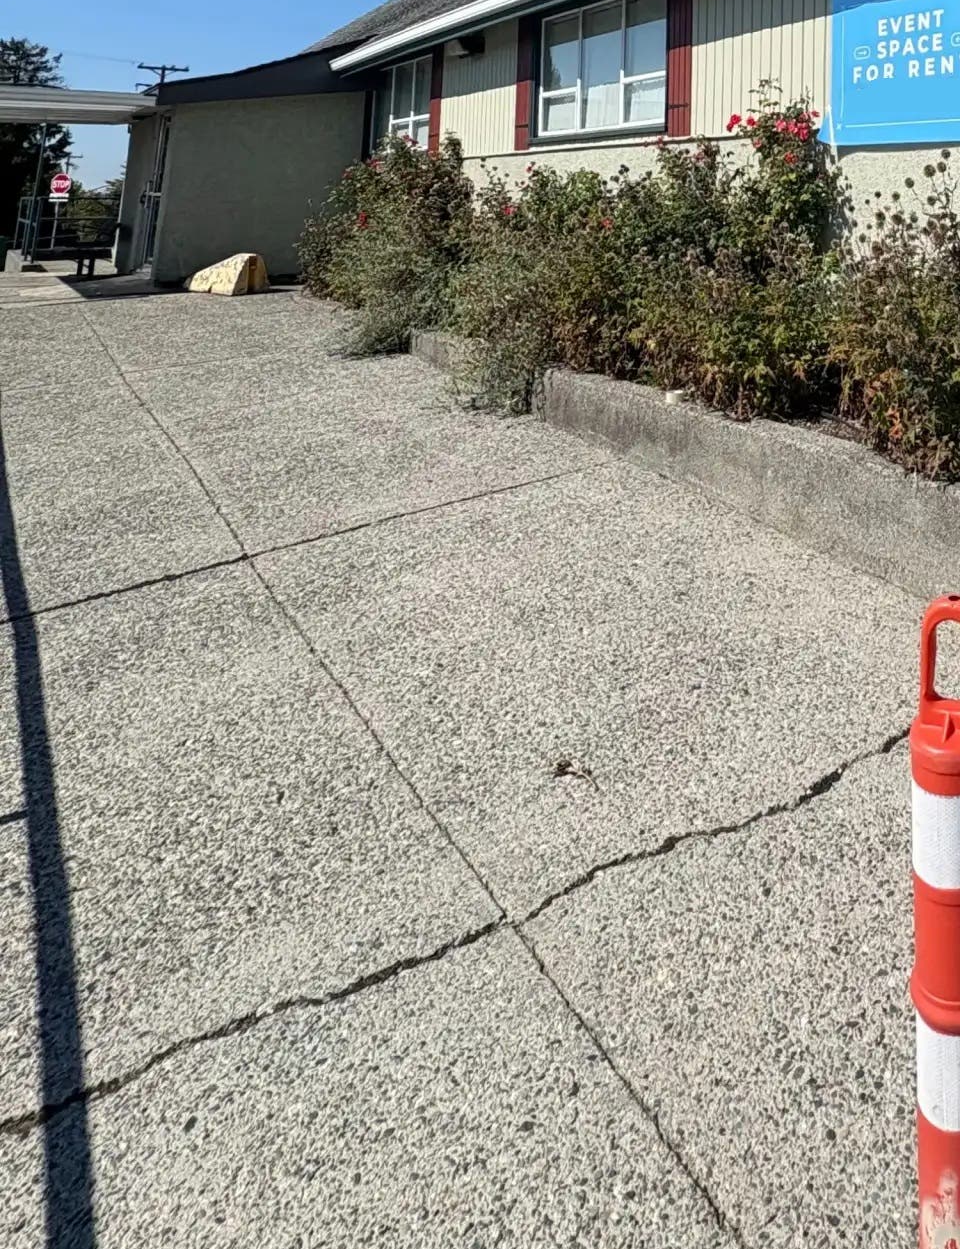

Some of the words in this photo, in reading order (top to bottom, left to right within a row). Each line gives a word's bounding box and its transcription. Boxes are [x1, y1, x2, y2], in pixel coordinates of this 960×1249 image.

[878, 9, 944, 37] EVENT
[877, 33, 943, 59] SPACE
[853, 63, 895, 84] FOR
[52, 180, 70, 189] STOP
